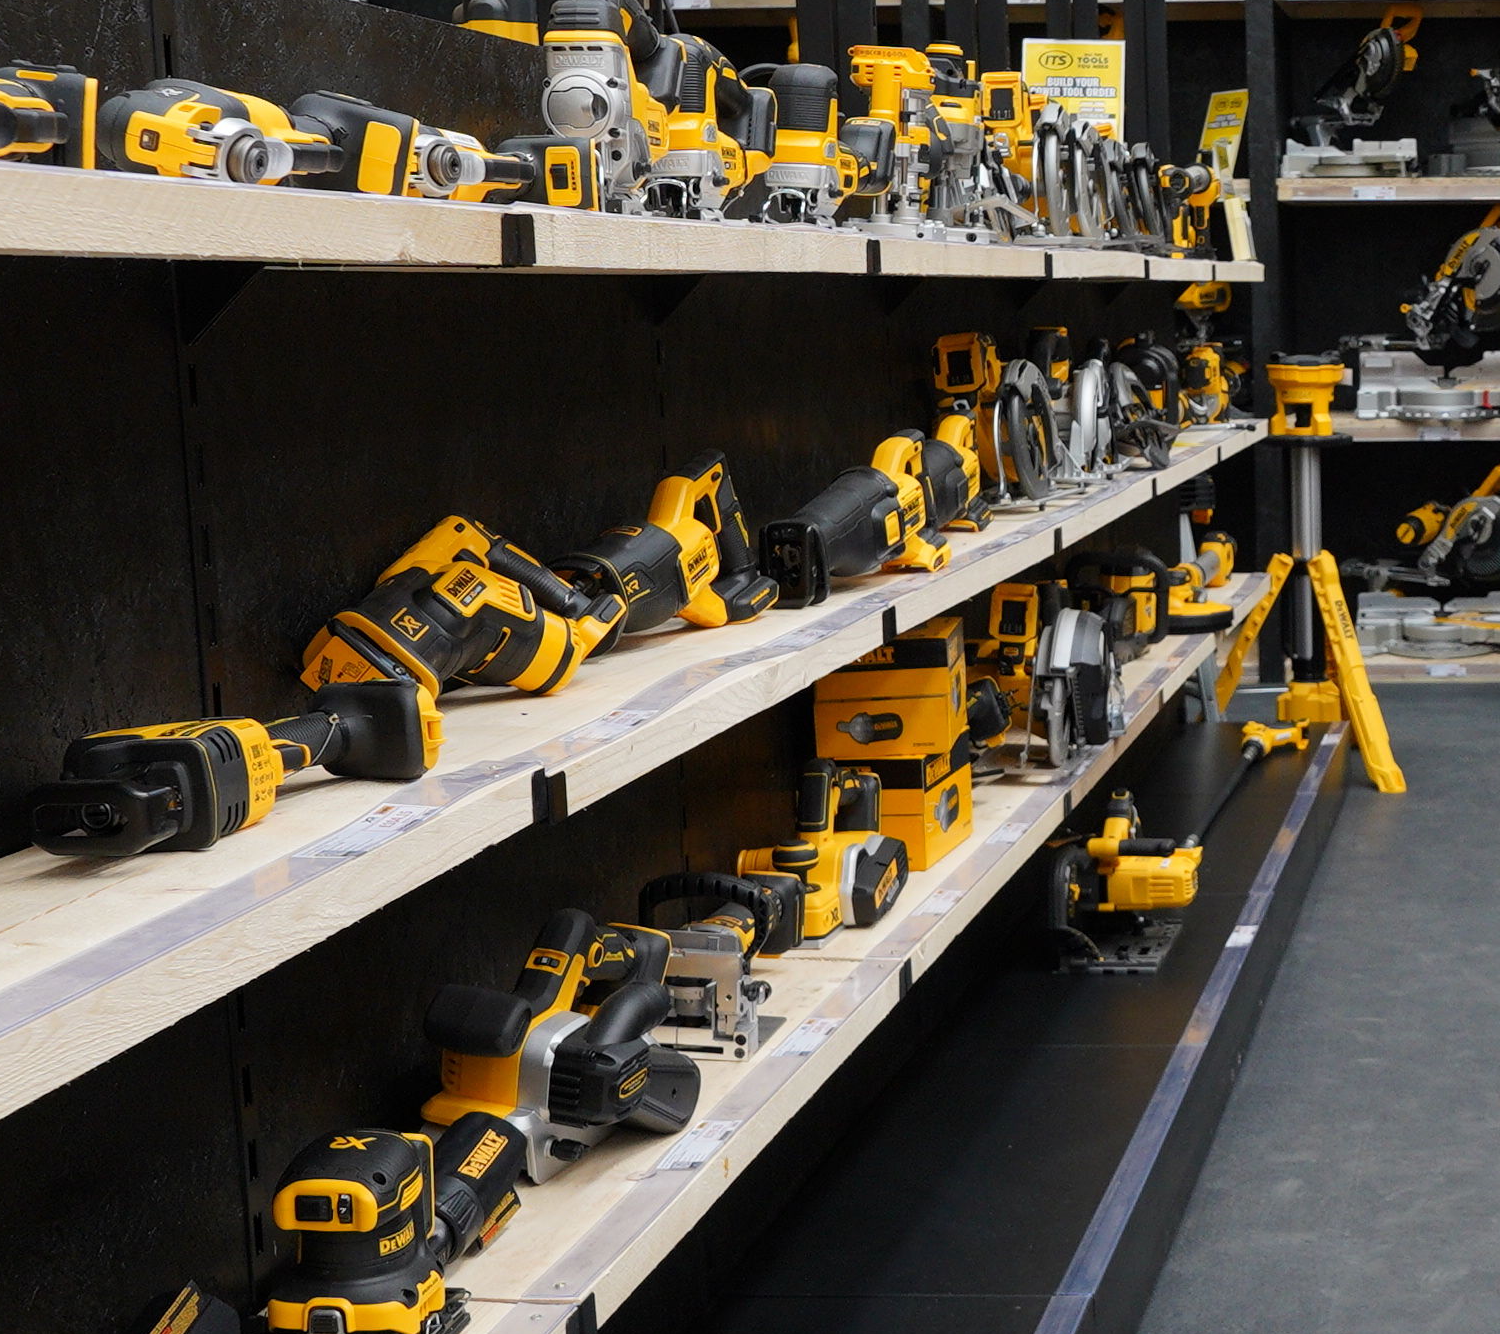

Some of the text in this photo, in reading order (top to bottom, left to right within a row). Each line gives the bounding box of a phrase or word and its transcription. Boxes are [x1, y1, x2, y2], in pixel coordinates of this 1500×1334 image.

[1045, 54, 1067, 66] ITS
[1046, 77, 1099, 87] BUILD YOUR
[1062, 87, 1116, 97] TOOL ORDER
[398, 614, 423, 636] XR
